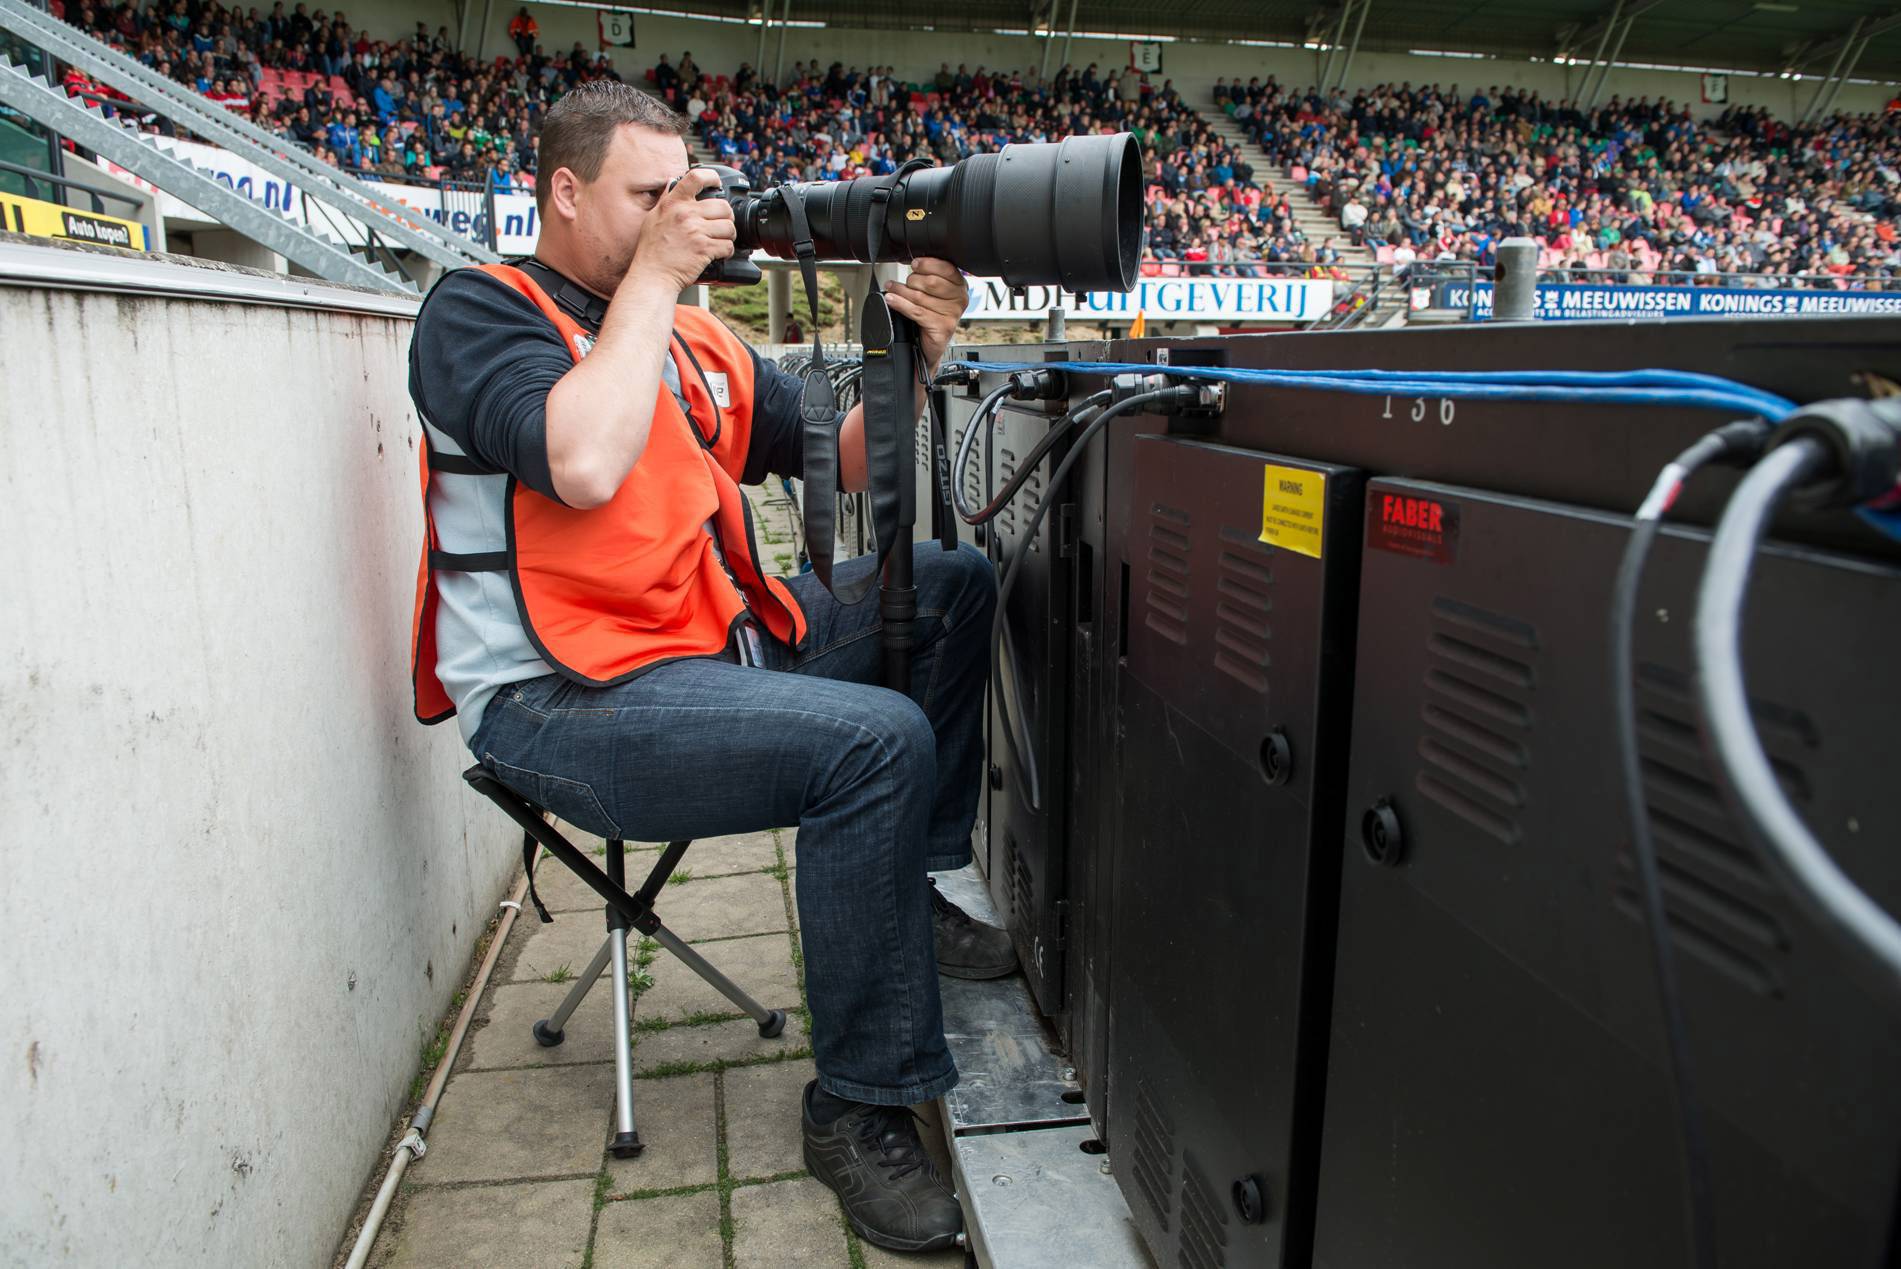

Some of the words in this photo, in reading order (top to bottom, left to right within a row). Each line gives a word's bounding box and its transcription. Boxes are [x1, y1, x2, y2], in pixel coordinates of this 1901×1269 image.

[612, 23, 622, 37] D
[1143, 52, 1151, 65] E
[68, 215, 94, 238] Auto
[94, 222, 129, 244] kopen?
[1450, 289, 1541, 308] KONS
[1562, 290, 1692, 310] MEEUWISSEN
[1700, 294, 1783, 313] KONINGS
[1383, 495, 1443, 532] FABER
